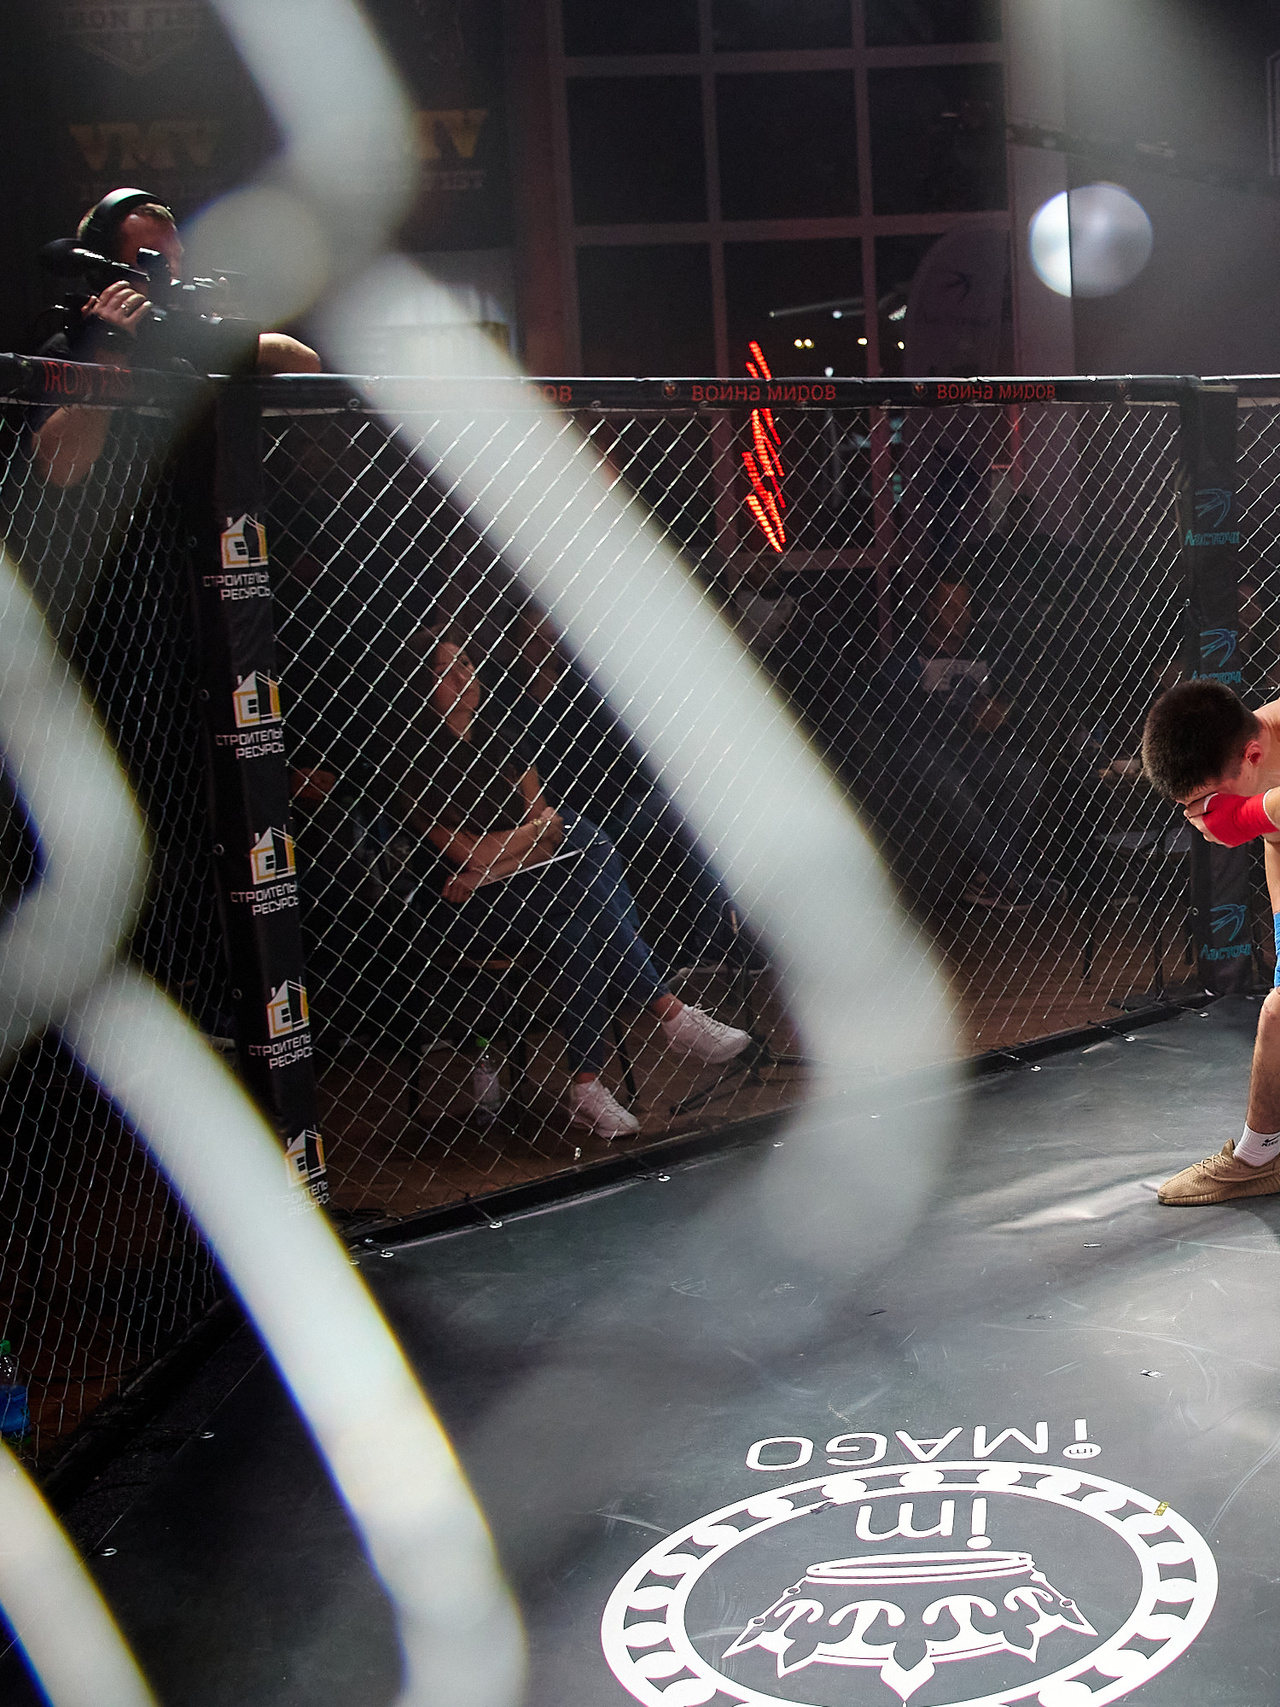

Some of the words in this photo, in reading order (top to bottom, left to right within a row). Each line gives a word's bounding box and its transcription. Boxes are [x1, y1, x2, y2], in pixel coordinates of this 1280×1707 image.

[203, 572, 270, 587] СТРОИТЕЛЬ
[216, 727, 283, 746] СТРОИТЕЛЬ
[230, 881, 297, 903] СТРОИТЕЛЬ
[248, 1031, 312, 1056] СТРОИТЕЛЬ
[856, 1497, 992, 1549] im
